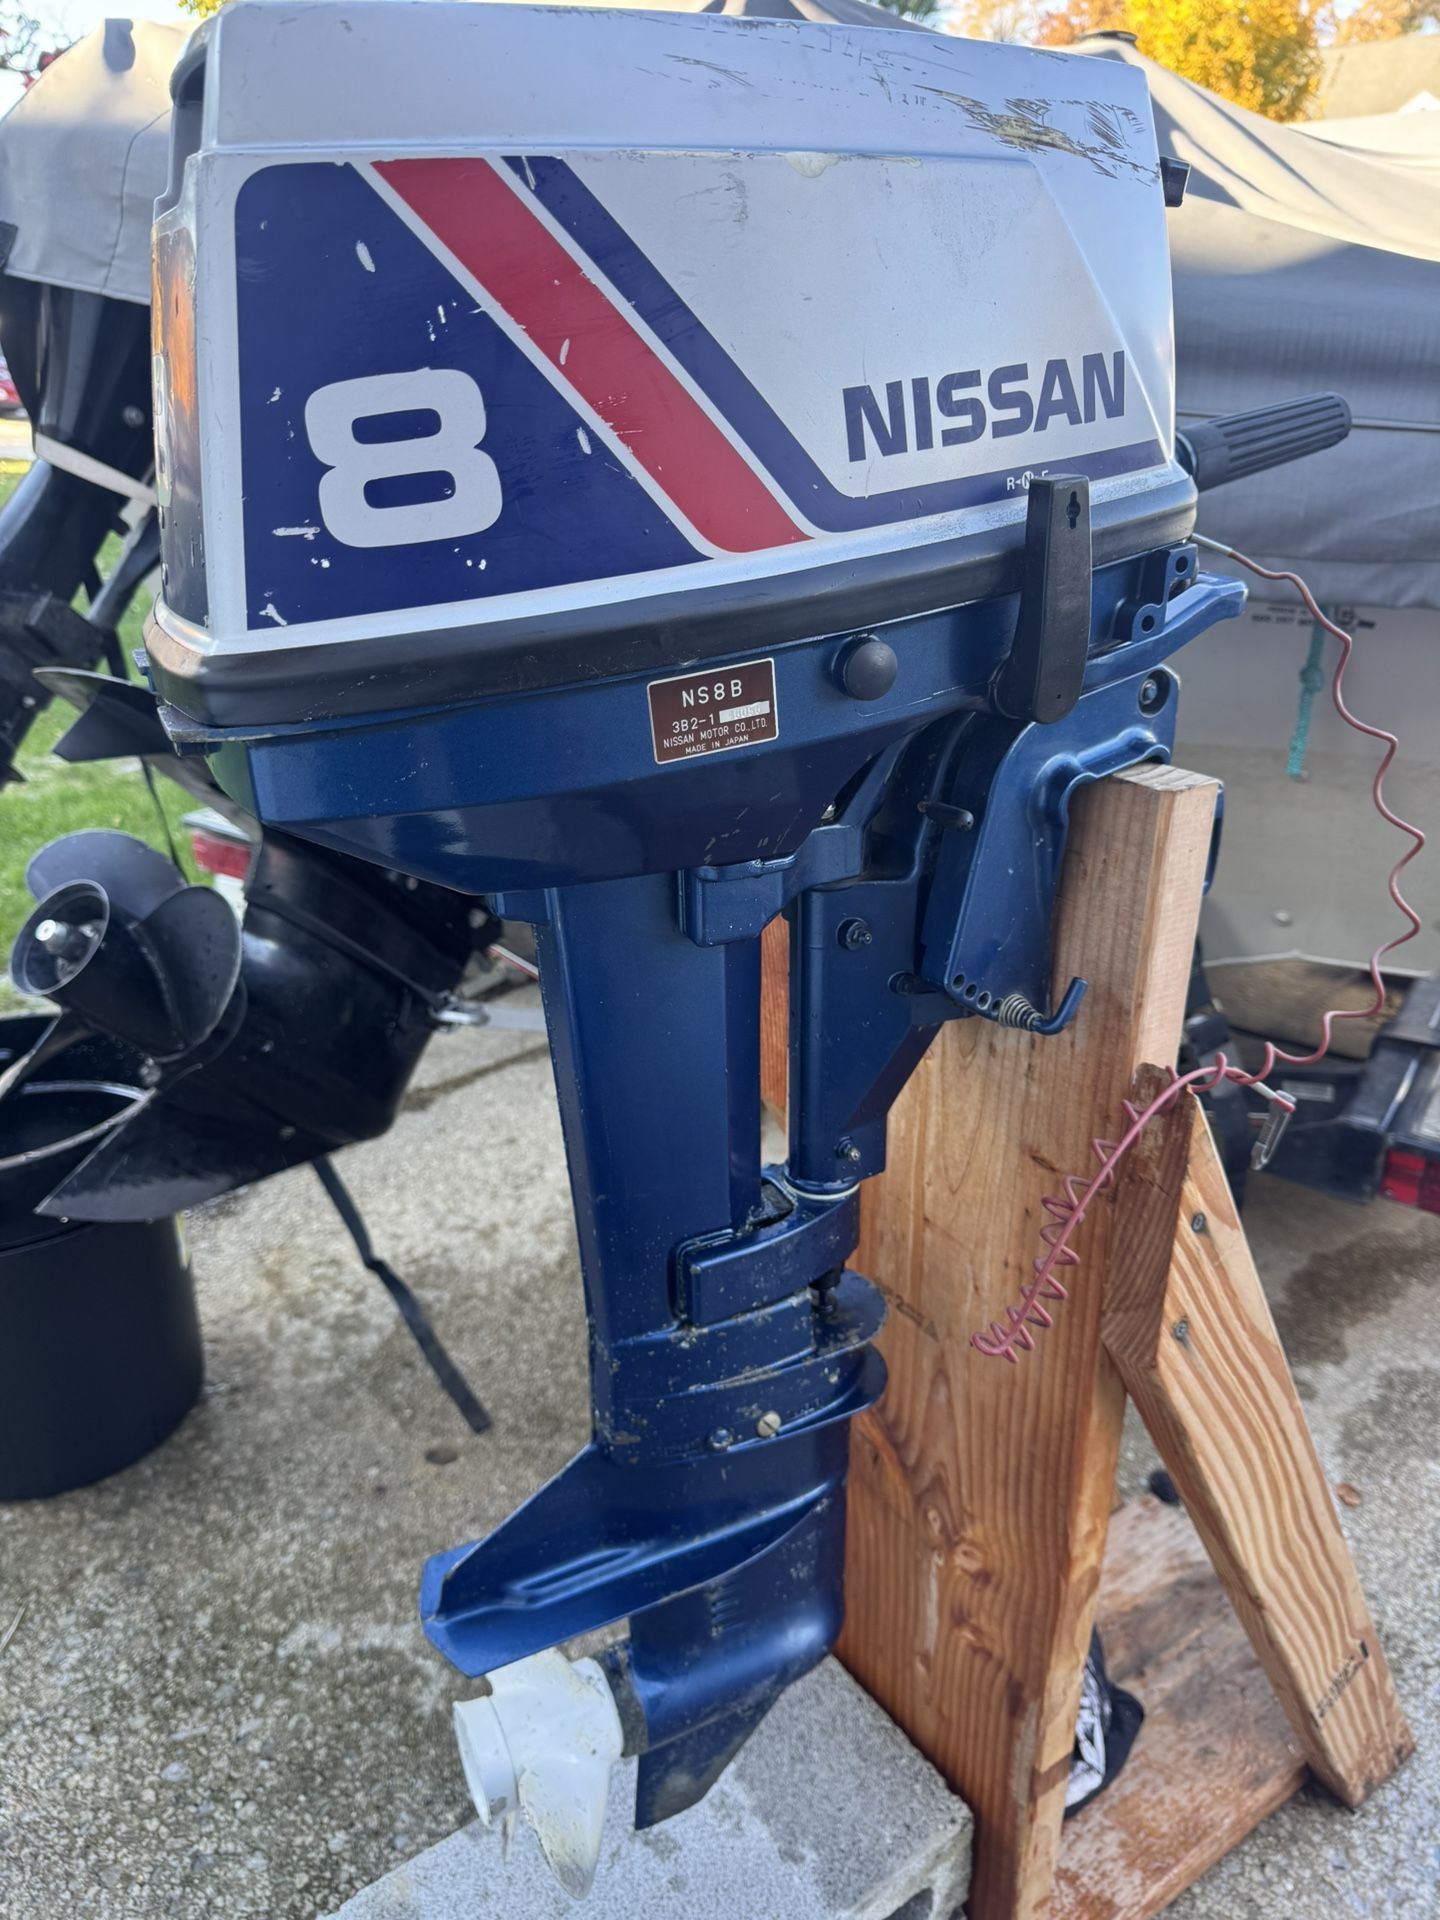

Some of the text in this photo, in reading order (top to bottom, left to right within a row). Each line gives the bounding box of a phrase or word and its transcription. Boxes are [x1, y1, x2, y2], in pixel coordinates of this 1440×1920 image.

[843, 350, 1125, 463] NISSAN
[304, 367, 503, 548] 8
[681, 679, 743, 708] NS8B
[672, 713, 715, 733] 3B2-1
[663, 733, 695, 748] NISSAN
[700, 725, 729, 741] MOTOR
[685, 734, 749, 755] MADE IN JAPAN
